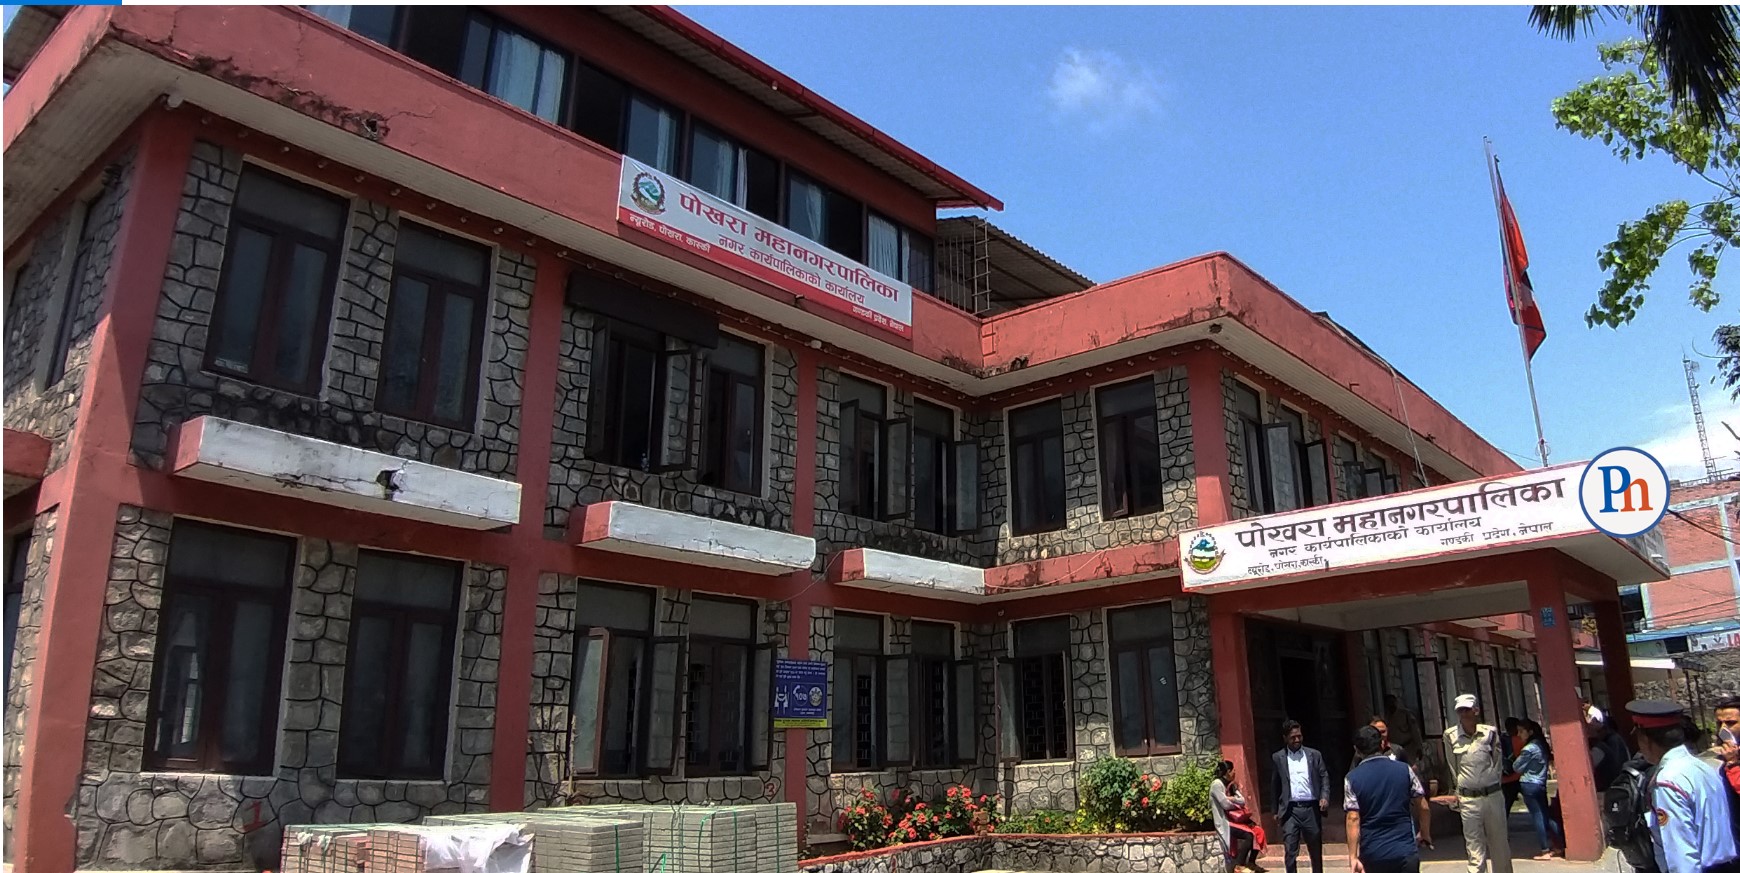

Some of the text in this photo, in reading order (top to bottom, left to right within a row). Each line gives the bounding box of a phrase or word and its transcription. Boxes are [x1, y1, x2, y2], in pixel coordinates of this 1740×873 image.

[679, 192, 899, 302] पोखरा महानगरपालिका
[718, 233, 865, 304] नगर कार्यपालिकाको कार्यालय
[1235, 477, 1566, 548] पोखरा महानगरपालिका
[1268, 517, 1482, 559] नगर कार्यपालिकाको कार्यालय
